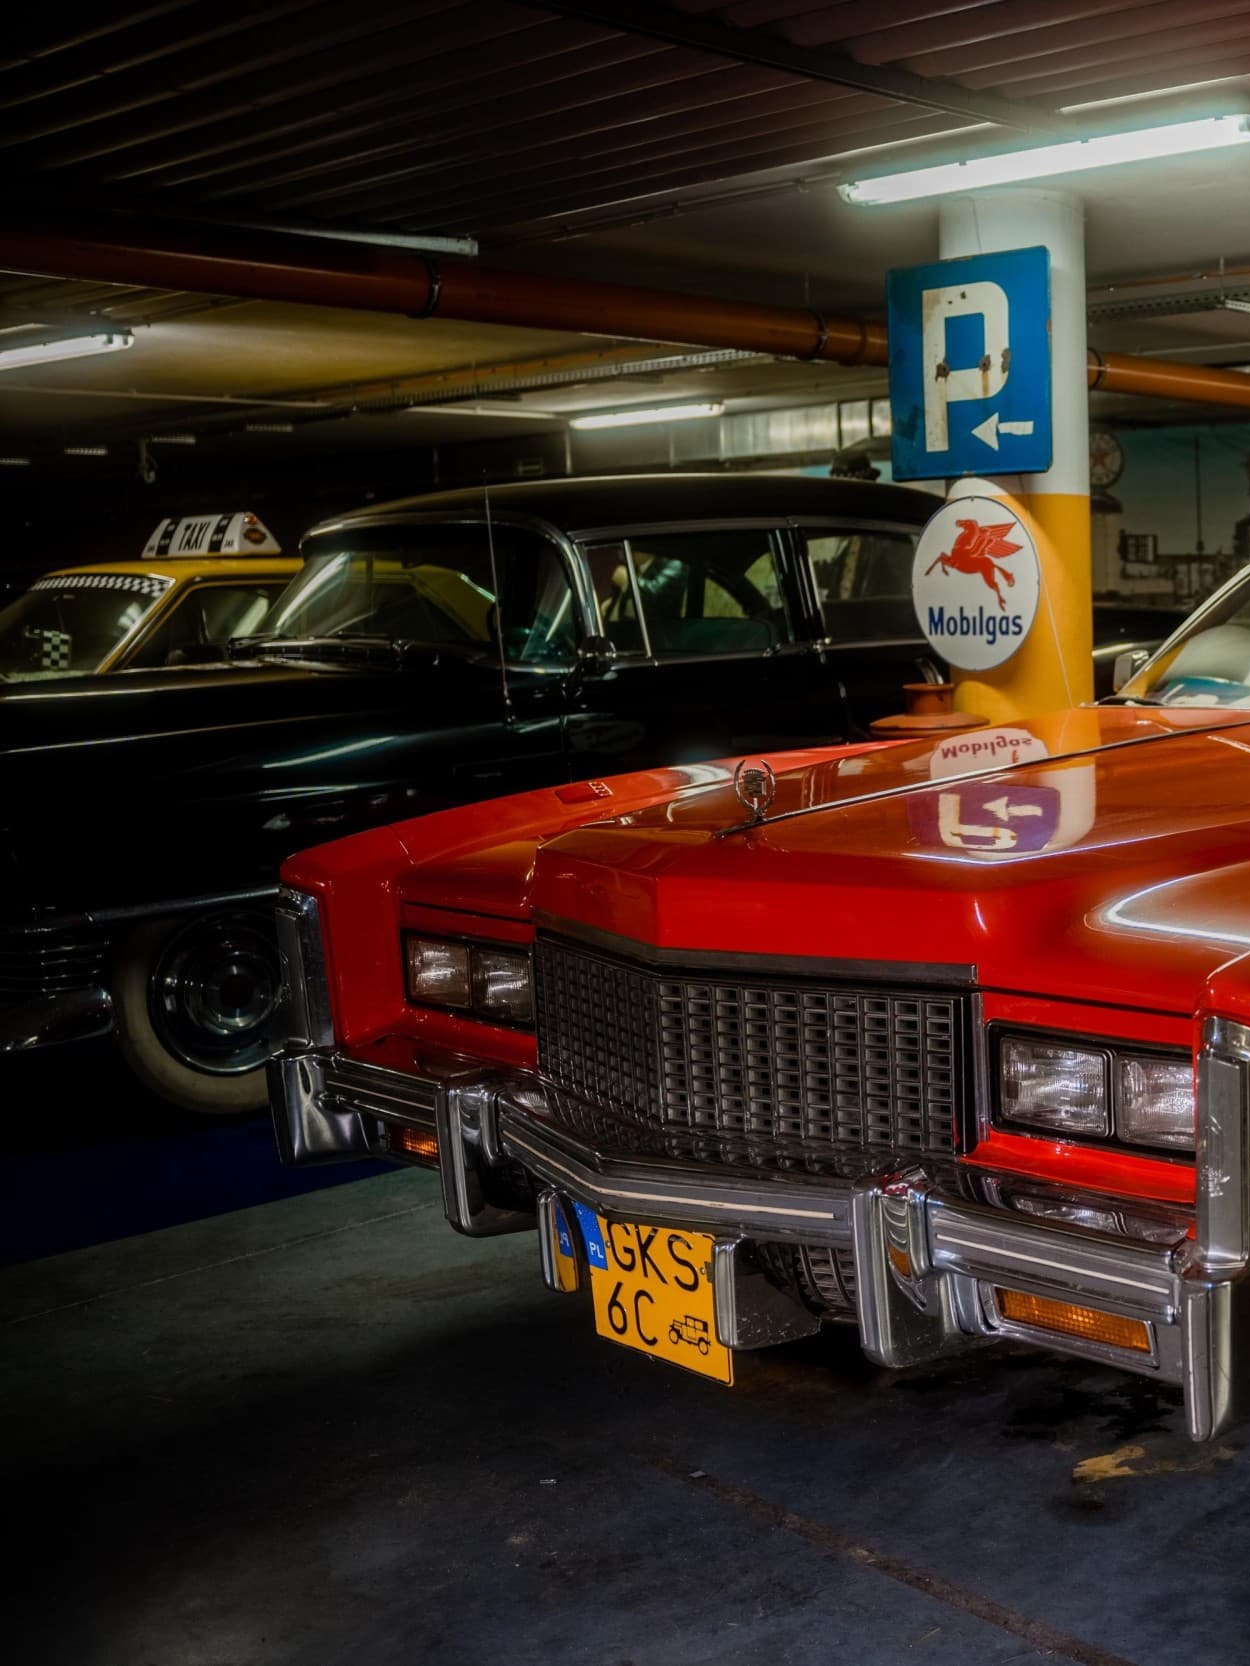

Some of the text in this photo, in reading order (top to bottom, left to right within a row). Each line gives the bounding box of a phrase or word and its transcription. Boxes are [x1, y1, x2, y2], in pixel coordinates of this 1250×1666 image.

[920, 280, 1010, 453] P
[178, 521, 211, 552] TAXI
[928, 605, 1023, 645] Mobilgas
[589, 1241, 604, 1259] PL
[607, 1221, 699, 1291] GKS
[608, 1281, 658, 1346] 6C
